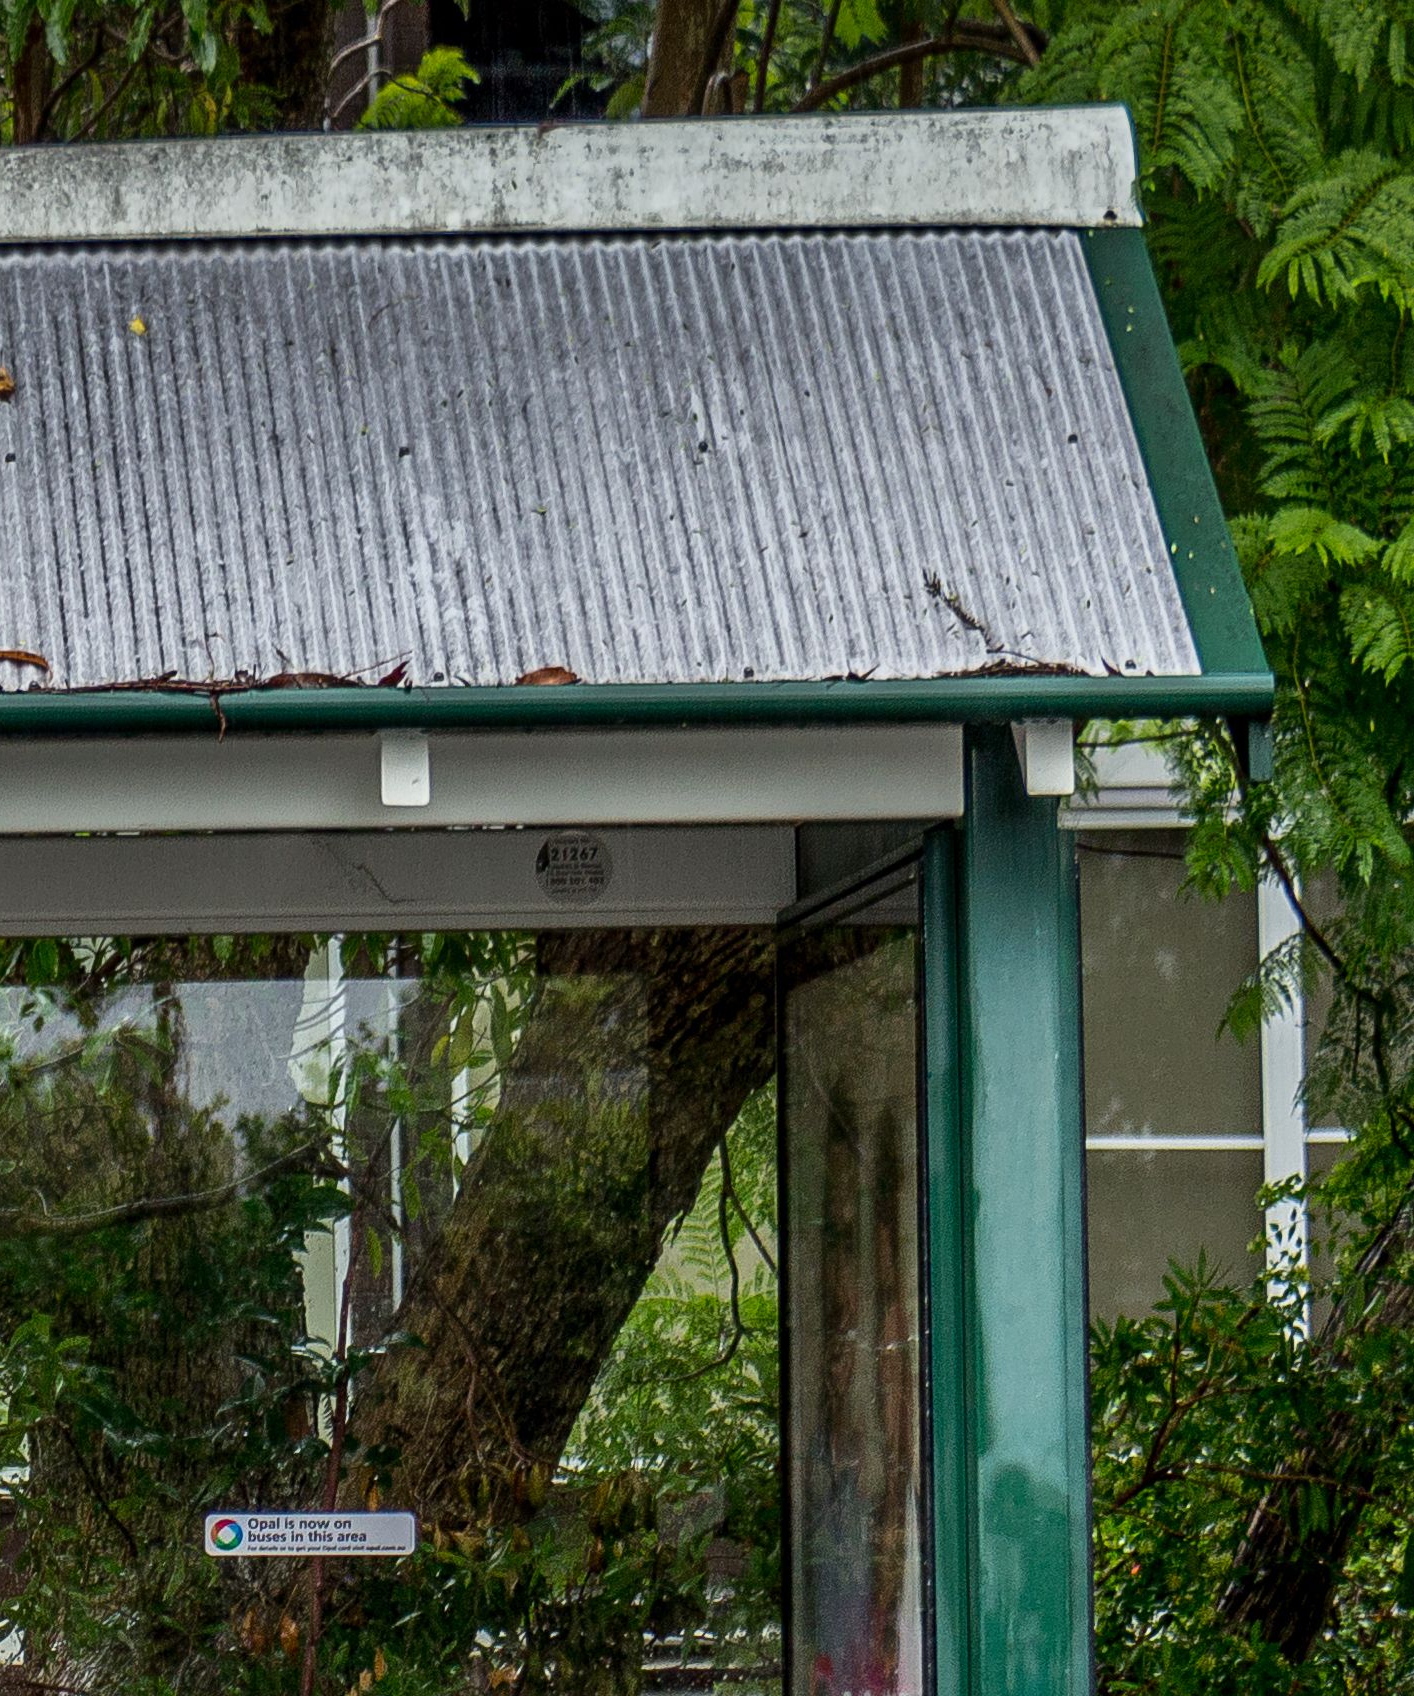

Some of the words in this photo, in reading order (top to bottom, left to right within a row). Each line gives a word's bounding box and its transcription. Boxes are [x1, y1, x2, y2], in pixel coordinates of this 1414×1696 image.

[551, 846, 598, 861] 21267
[248, 1517, 280, 1531] Opal
[285, 1517, 295, 1529] is
[299, 1520, 330, 1529] now
[334, 1520, 351, 1529] on
[248, 1531, 287, 1542] buses
[291, 1531, 304, 1542] in
[308, 1530, 333, 1542] this
[337, 1533, 367, 1542] area
